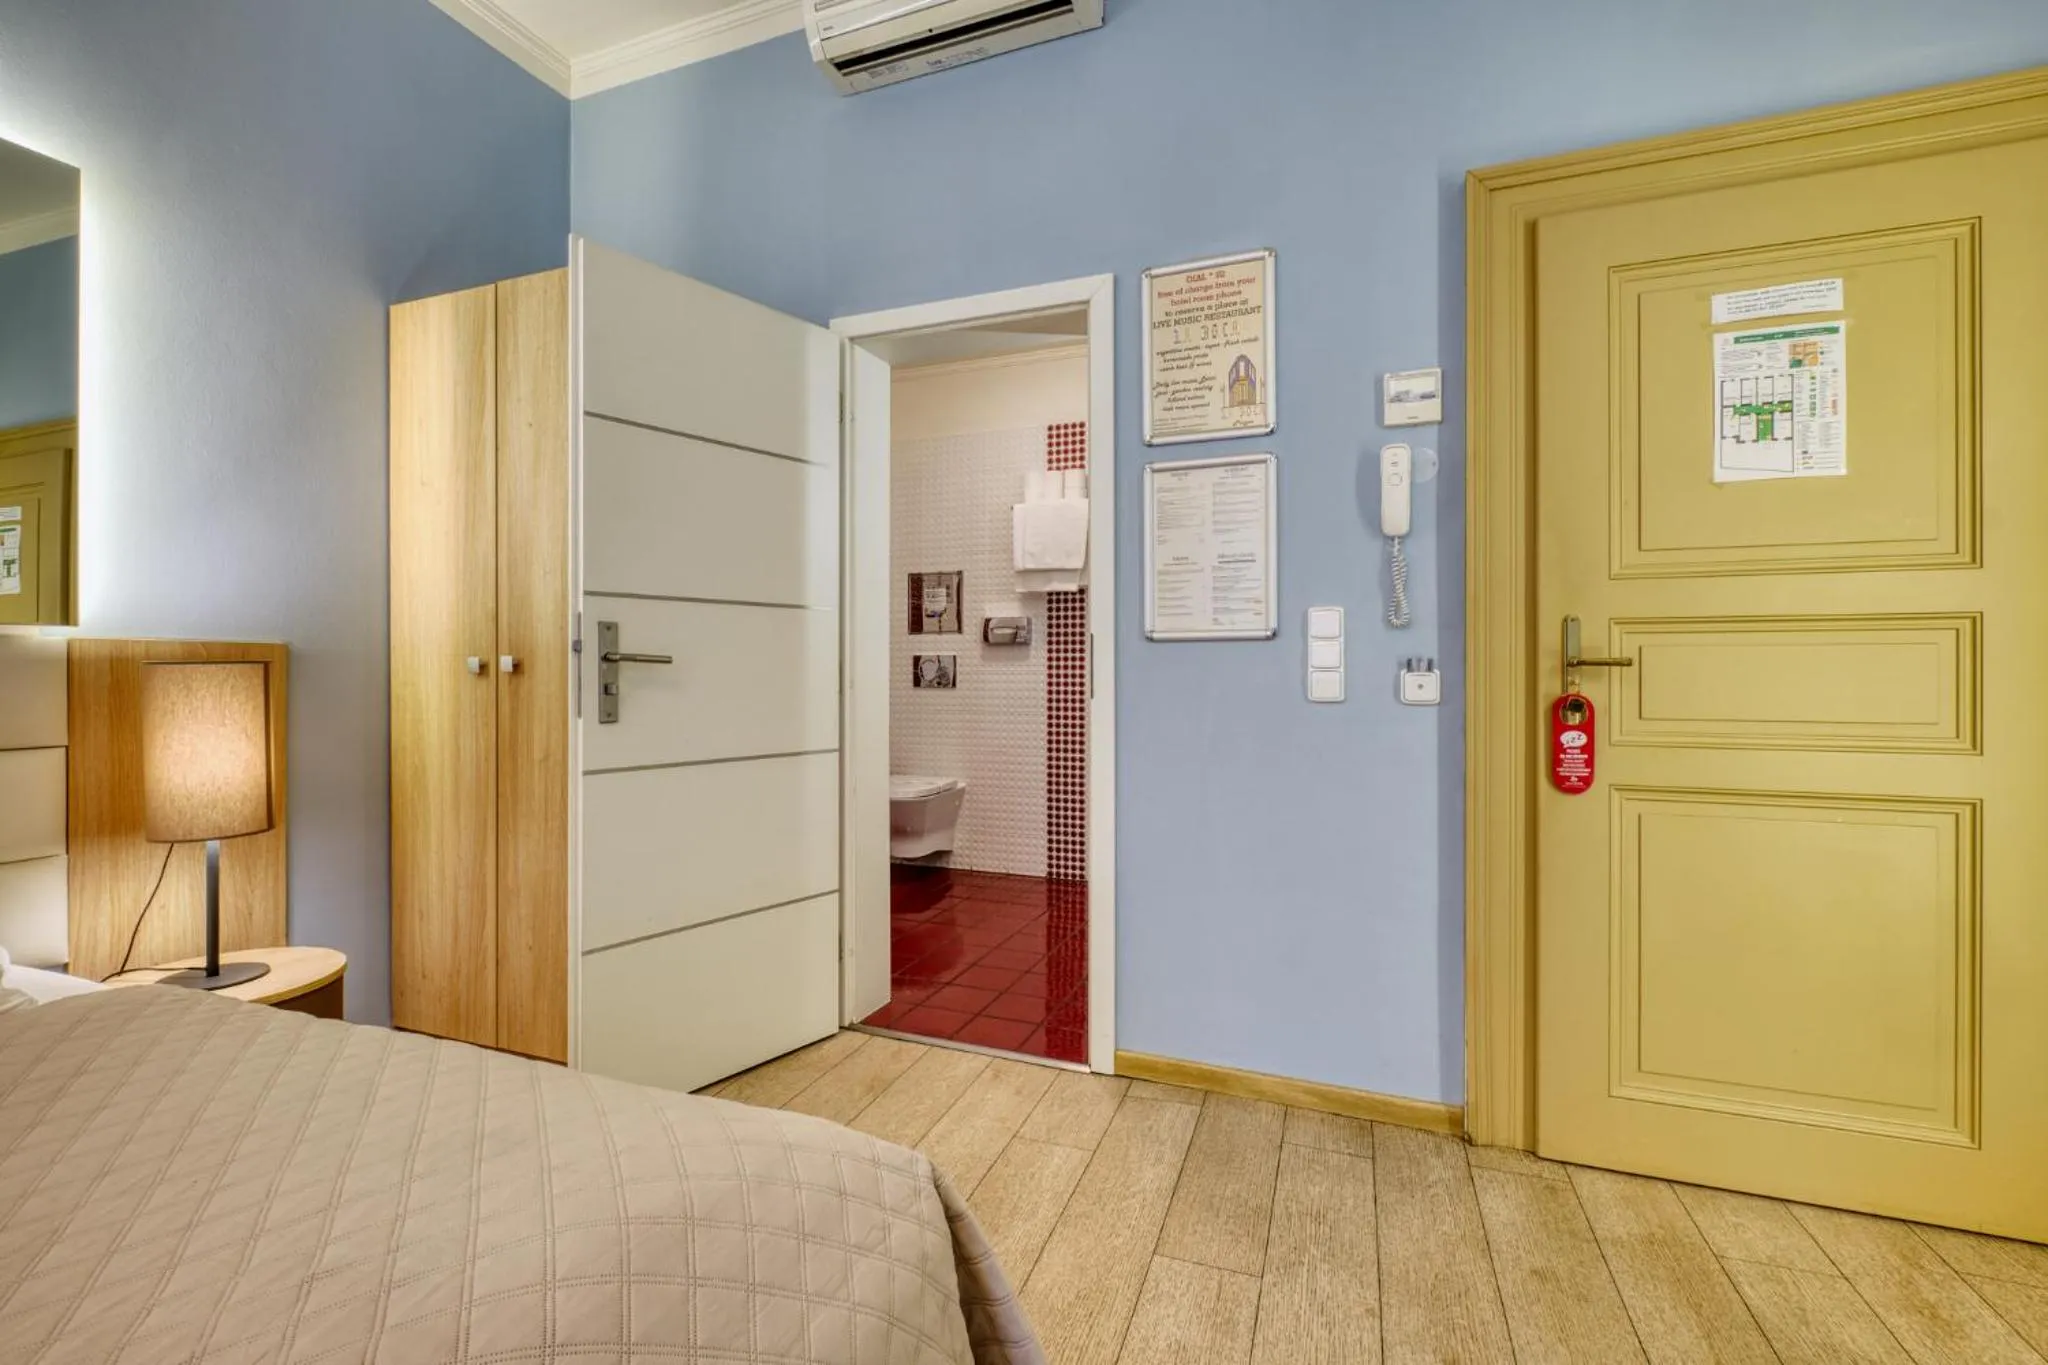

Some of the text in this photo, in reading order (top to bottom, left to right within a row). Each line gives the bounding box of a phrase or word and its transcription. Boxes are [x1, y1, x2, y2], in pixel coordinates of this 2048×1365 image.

[1153, 305, 1263, 330] LIVE MUSIC RESTAURANT
